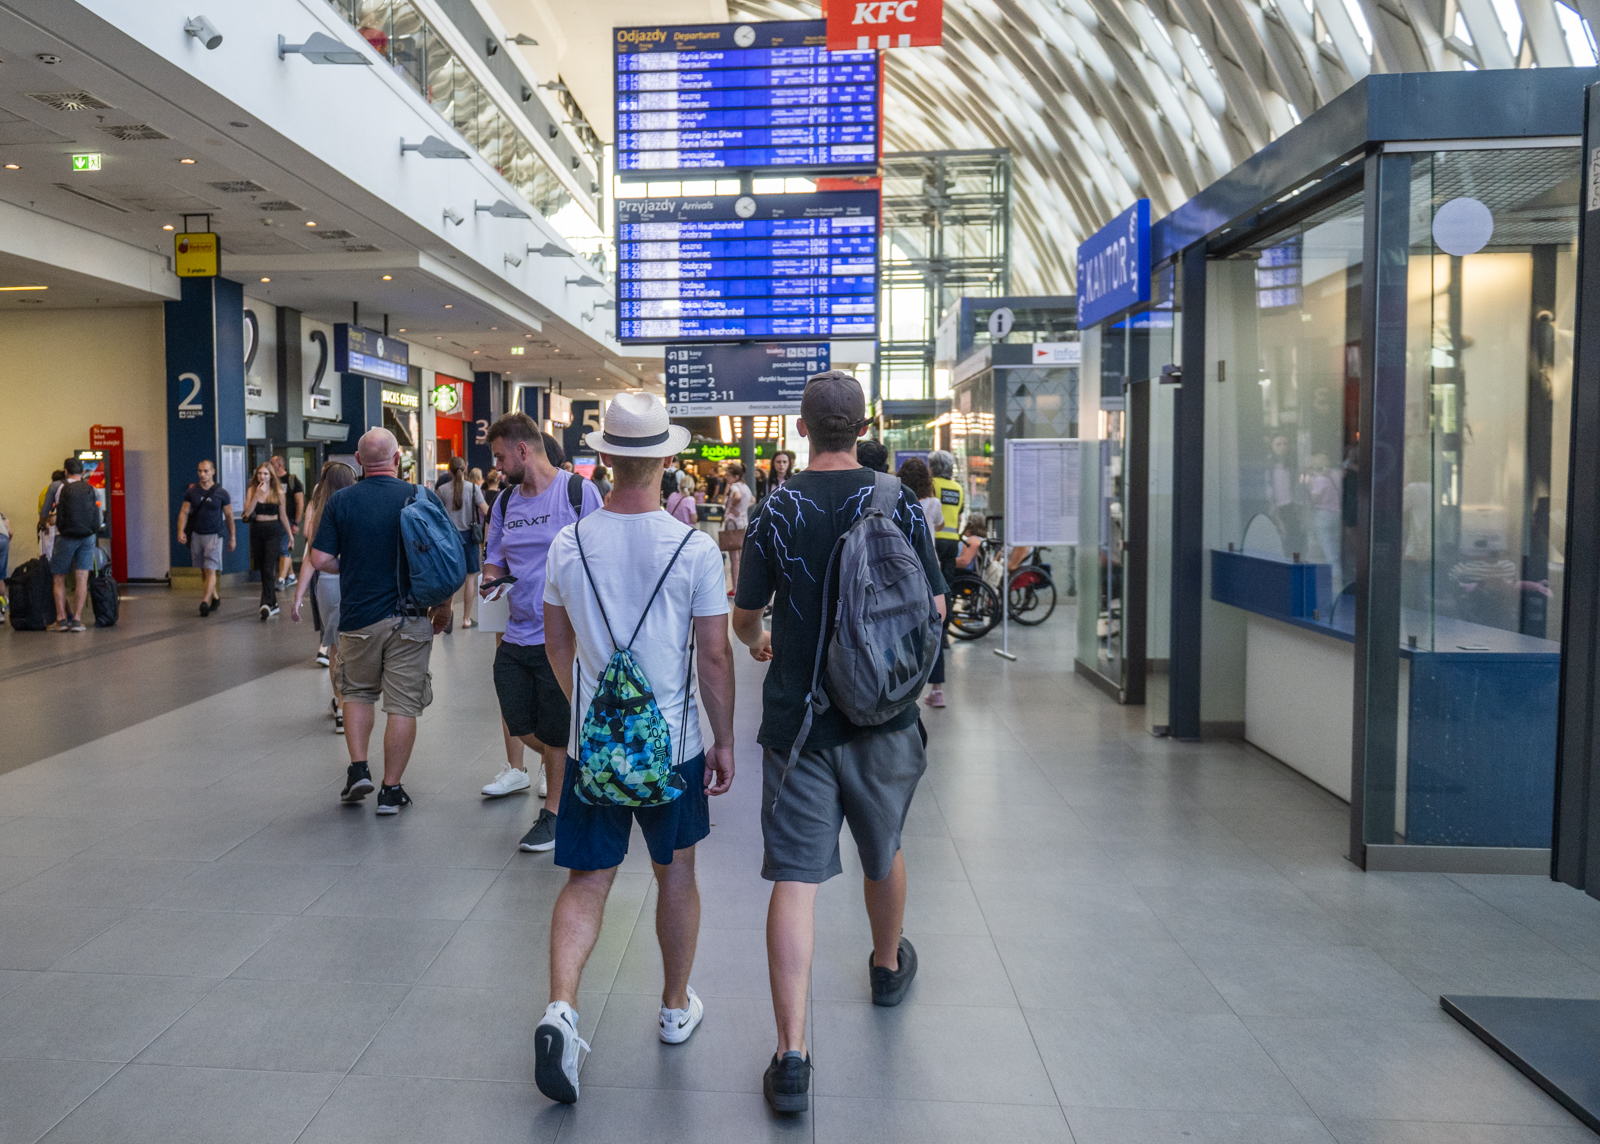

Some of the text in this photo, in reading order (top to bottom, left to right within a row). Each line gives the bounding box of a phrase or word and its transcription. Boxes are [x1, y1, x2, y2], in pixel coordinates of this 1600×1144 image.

[852, 1, 919, 25] KFC
[617, 29, 720, 44] Odjazdy Departures
[618, 200, 714, 213] Przyjazdy Arrivals
[1086, 236, 1128, 304] KANTOR
[309, 330, 331, 397] 2
[707, 363, 713, 373] 1
[708, 377, 715, 387] 2
[178, 372, 202, 410] 2
[710, 390, 734, 401] 3-11
[400, 393, 419, 408] COFFEE
[476, 420, 489, 440] 3
[582, 409, 600, 439] 5
[701, 445, 740, 457] żabka
